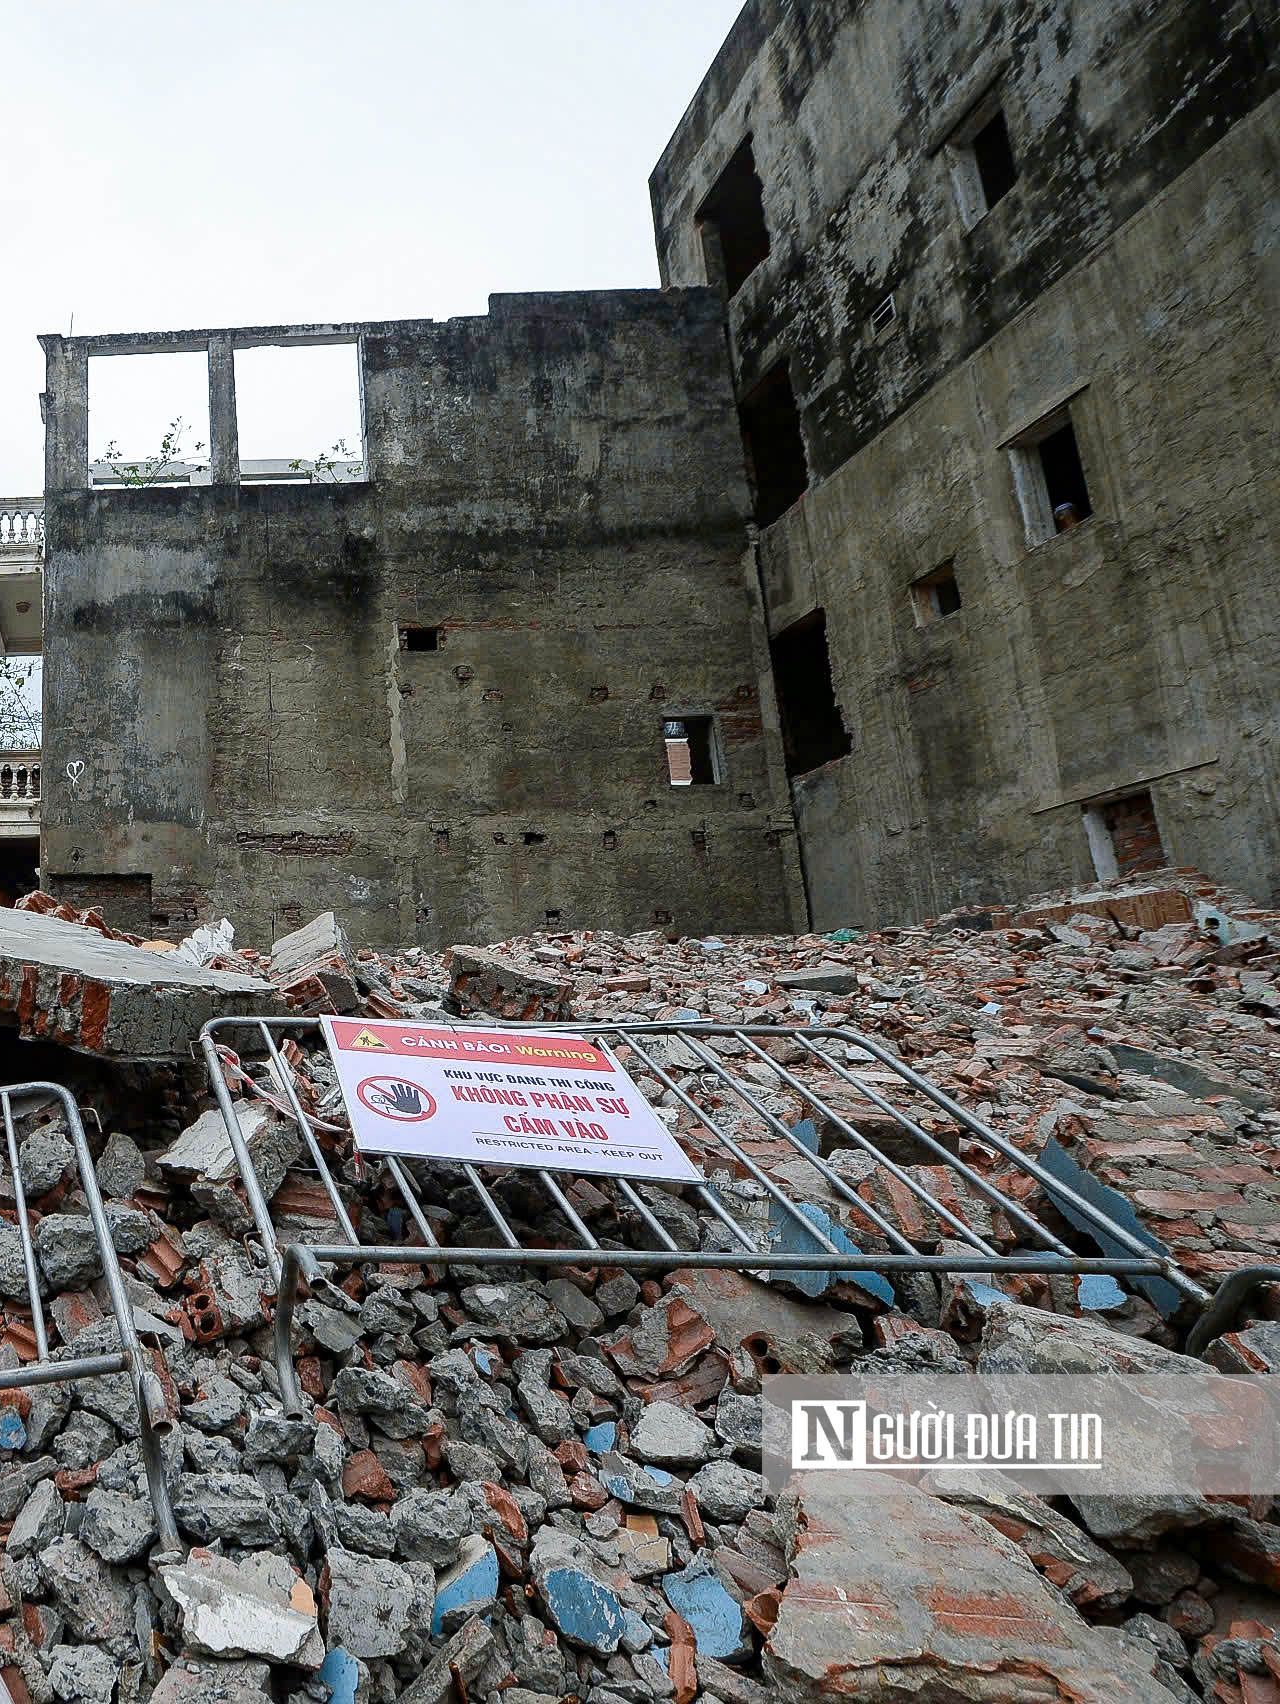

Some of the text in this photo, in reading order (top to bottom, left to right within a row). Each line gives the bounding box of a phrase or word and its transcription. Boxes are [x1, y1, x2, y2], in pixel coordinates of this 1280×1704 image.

[463, 1041, 511, 1055] BÁO!
[514, 1045, 597, 1062] Warning
[443, 1069, 615, 1092] KHU VỰC ĐANG THI CÔNG
[451, 1084, 631, 1119] KHÔNG PHẬN SỰ
[503, 1111, 609, 1141] CẤM VÀO
[475, 1137, 554, 1151] RESTRICTED
[558, 1144, 591, 1155] AREA
[601, 1149, 635, 1158] KEEP
[639, 1152, 663, 1162] OUT
